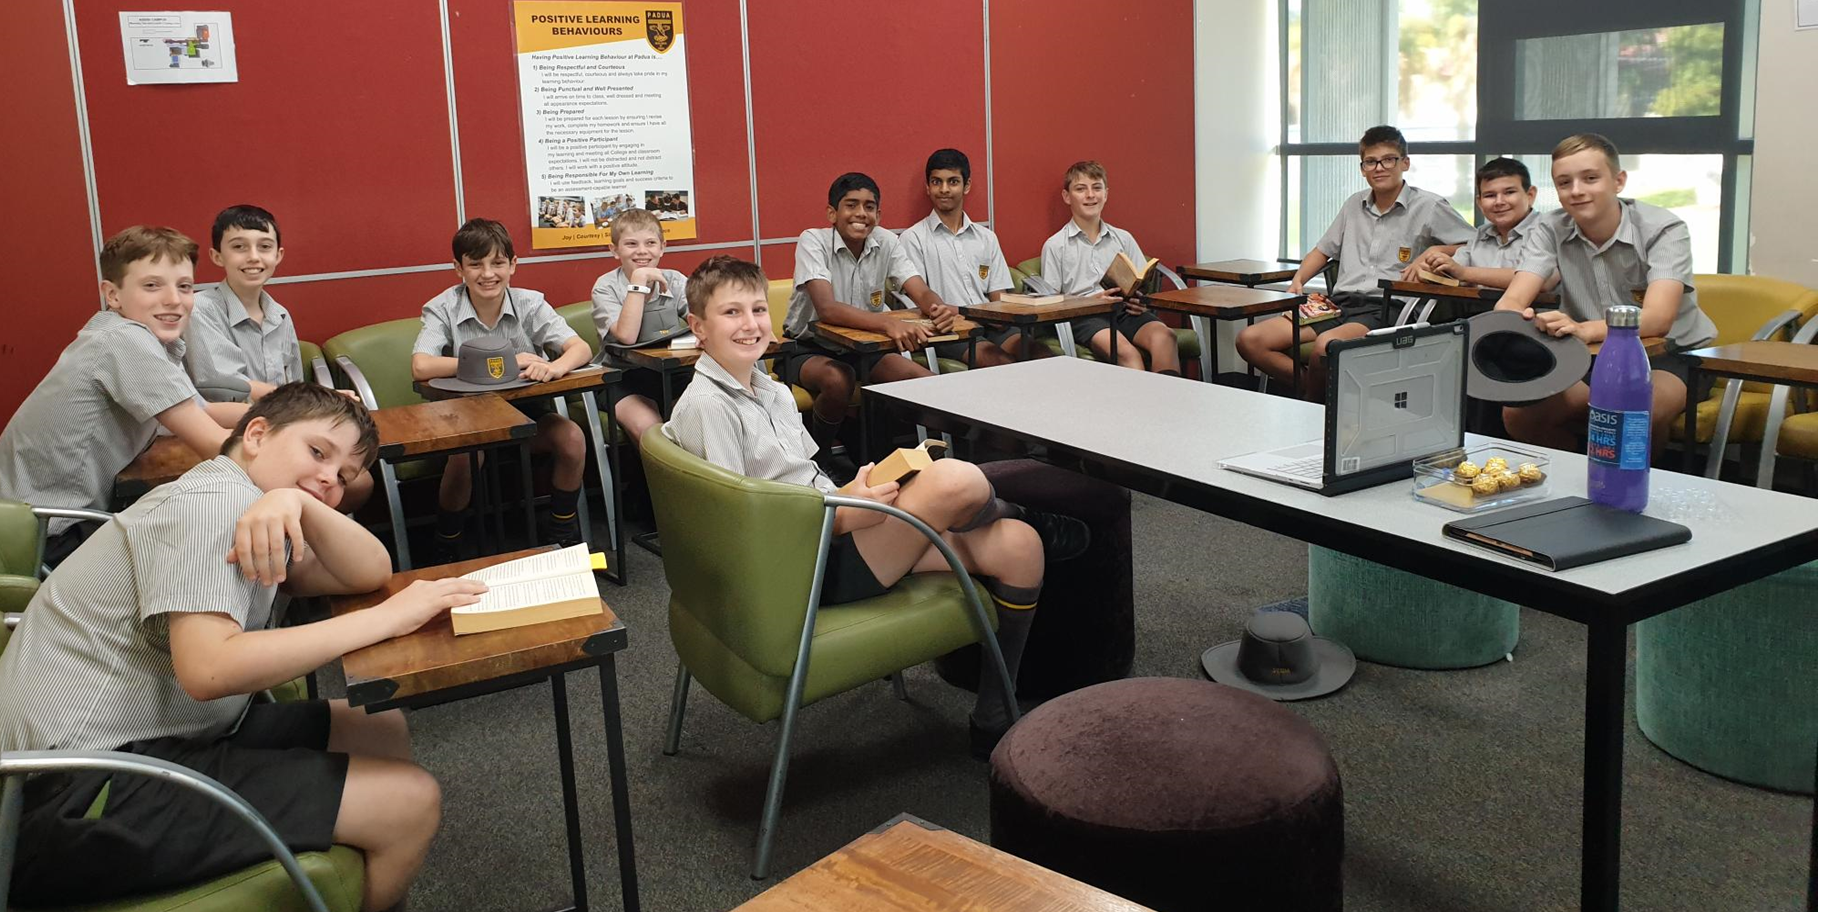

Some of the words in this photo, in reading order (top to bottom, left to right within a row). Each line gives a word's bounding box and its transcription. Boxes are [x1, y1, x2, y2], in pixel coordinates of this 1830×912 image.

[531, 15, 583, 23] POSITIVE
[586, 16, 640, 24] LEARNING
[552, 27, 623, 35] BEHAVIOURS
[1596, 435, 1616, 446] HRS
[1596, 448, 1615, 459] HRS
